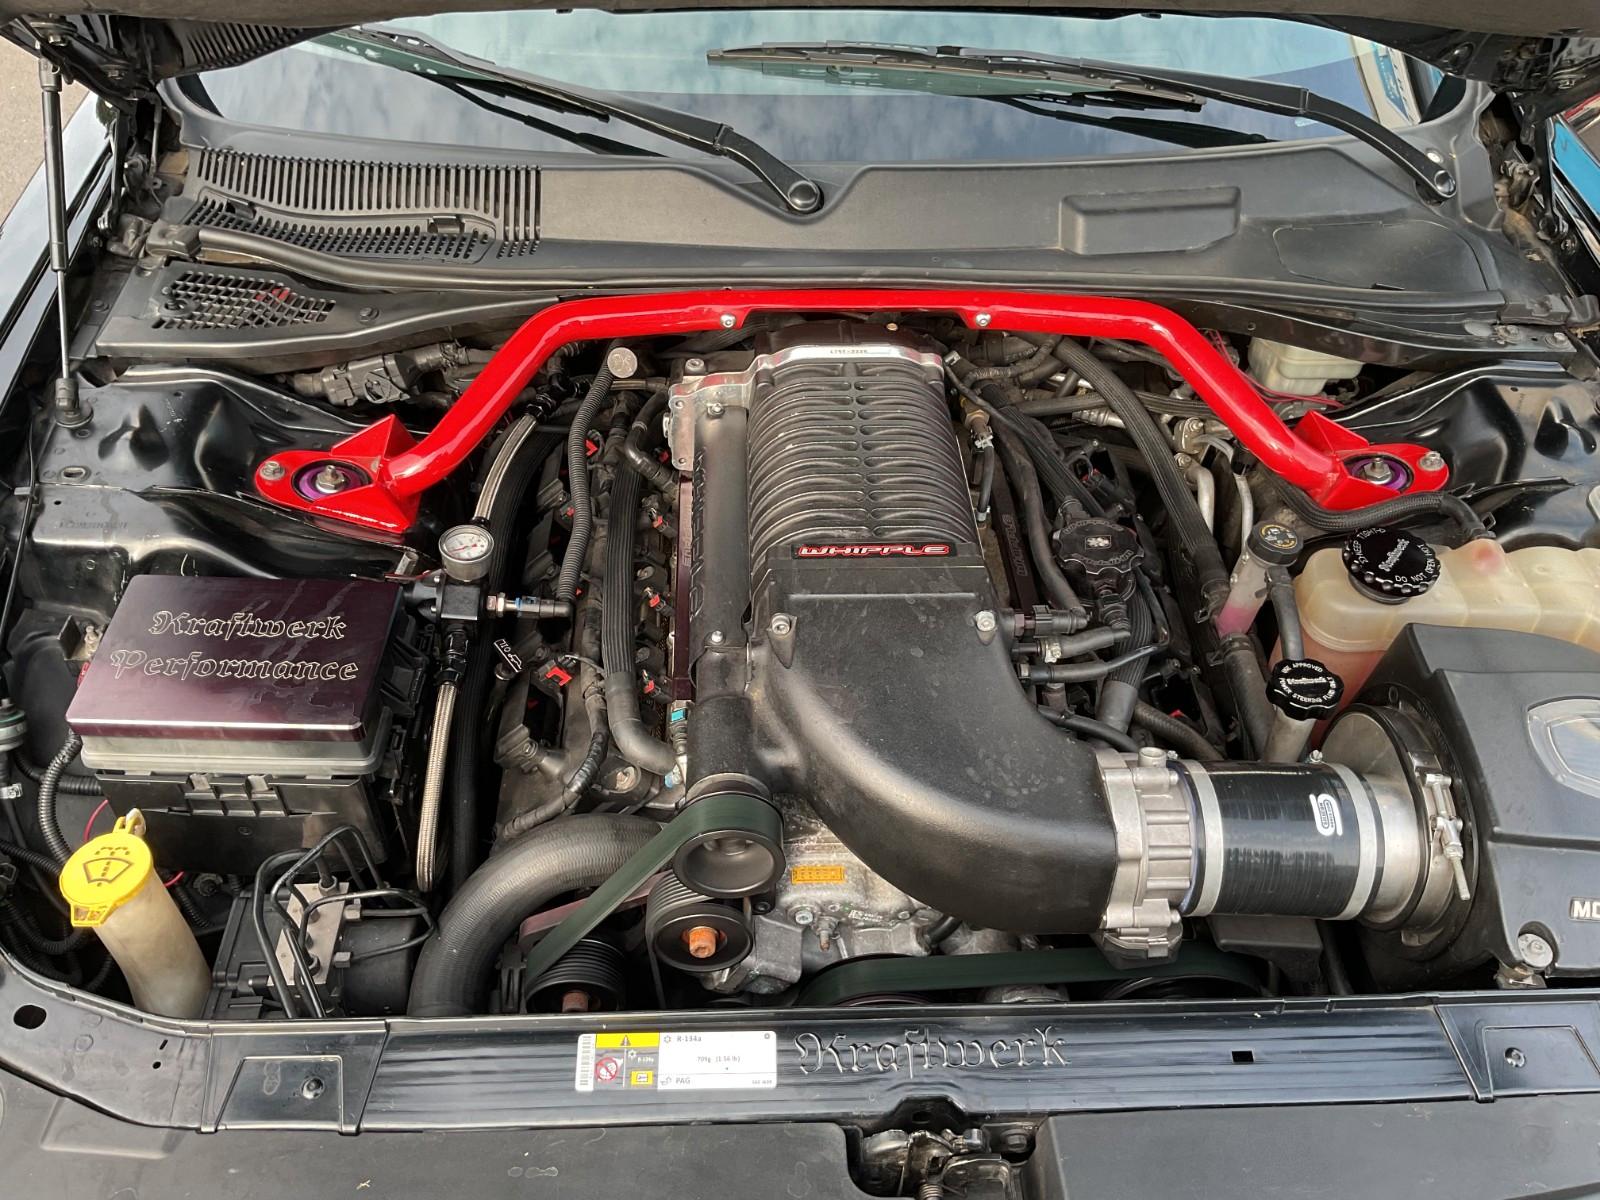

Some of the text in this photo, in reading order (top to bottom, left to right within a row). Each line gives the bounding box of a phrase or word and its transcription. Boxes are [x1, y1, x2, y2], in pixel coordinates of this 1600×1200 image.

[799, 544, 950, 557] WHIPPLE
[1417, 544, 1432, 555] HOT
[1395, 575, 1408, 583] DO
[1410, 573, 1427, 582] NOT
[148, 610, 347, 641] Kraftwerk
[110, 649, 359, 681] Performance
[1292, 663, 1323, 673] APPROVED
[794, 1026, 1071, 1079] Kraftwerk
